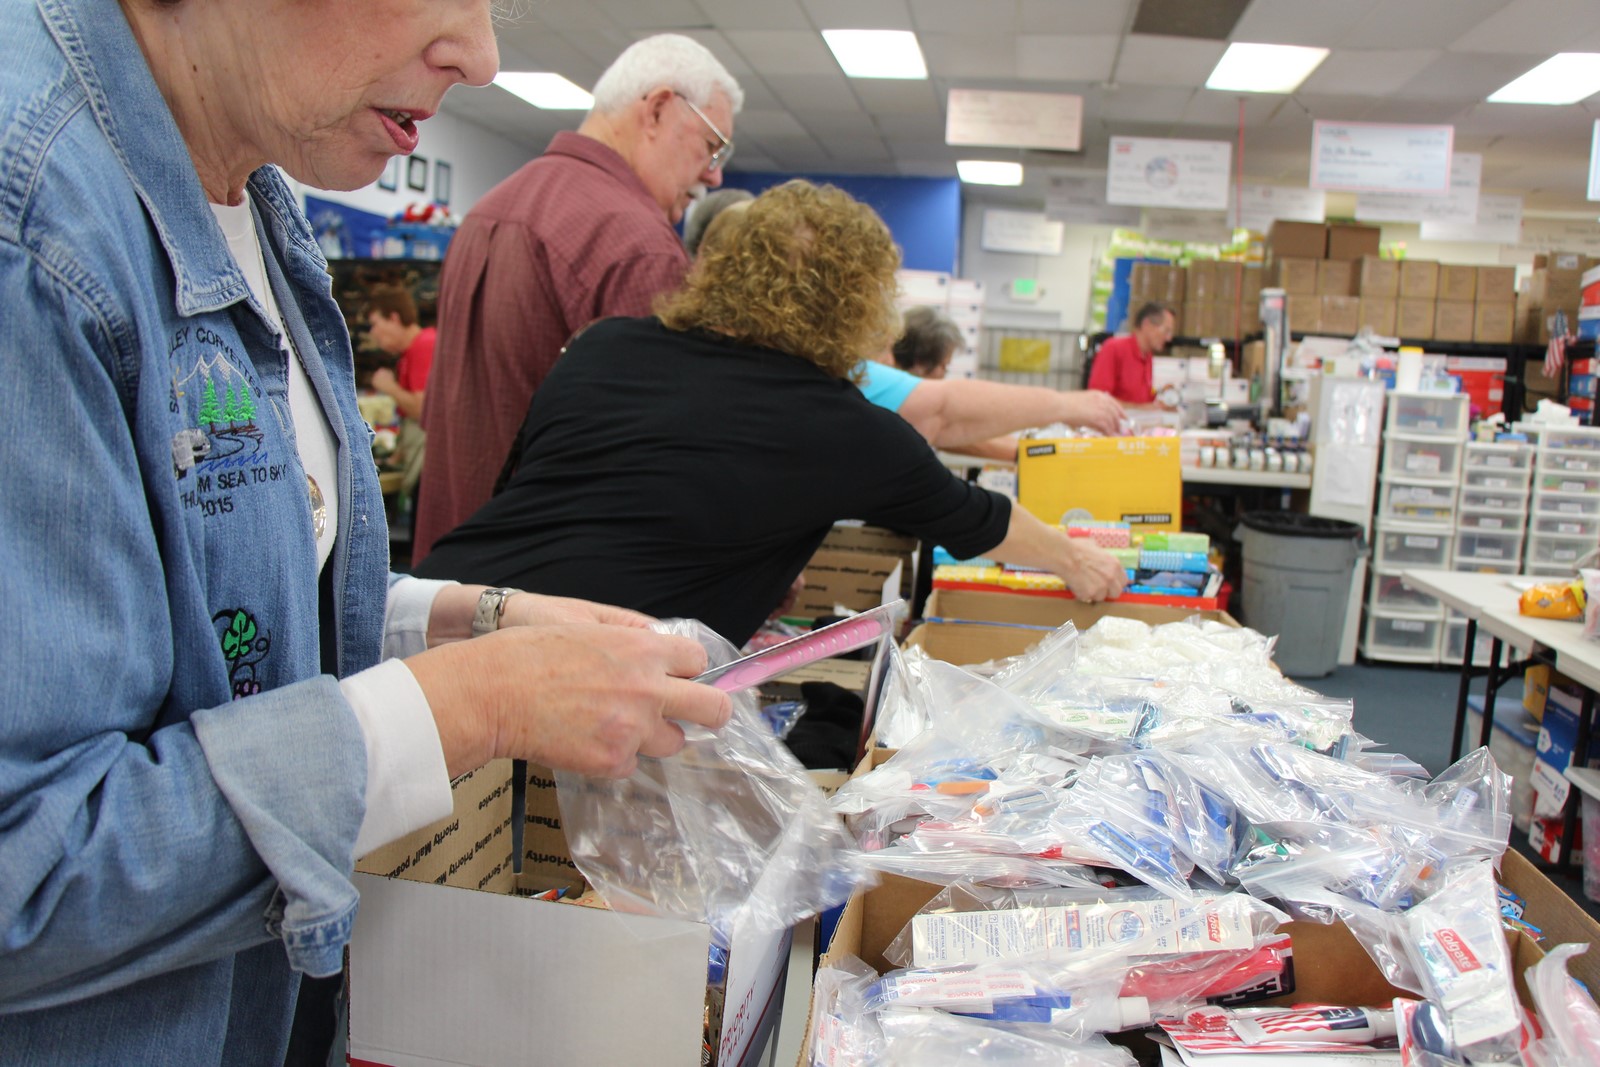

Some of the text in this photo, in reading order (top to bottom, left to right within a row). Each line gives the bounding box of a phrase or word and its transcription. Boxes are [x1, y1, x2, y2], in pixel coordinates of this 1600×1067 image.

[218, 470, 247, 490] SEA
[251, 467, 267, 483] TO
[270, 464, 287, 481] SKY
[202, 496, 234, 517] 2015
[478, 786, 502, 810] Service
[433, 818, 459, 846] Priority
[474, 833, 492, 852] using
[493, 824, 503, 838] for
[448, 848, 474, 876] Priority
[478, 863, 502, 889] Service
[1440, 929, 1473, 969] Colgate
[901, 976, 937, 985] BANDAGE
[947, 990, 984, 998] BANDAGE
[721, 986, 753, 1057] PRIORITY
